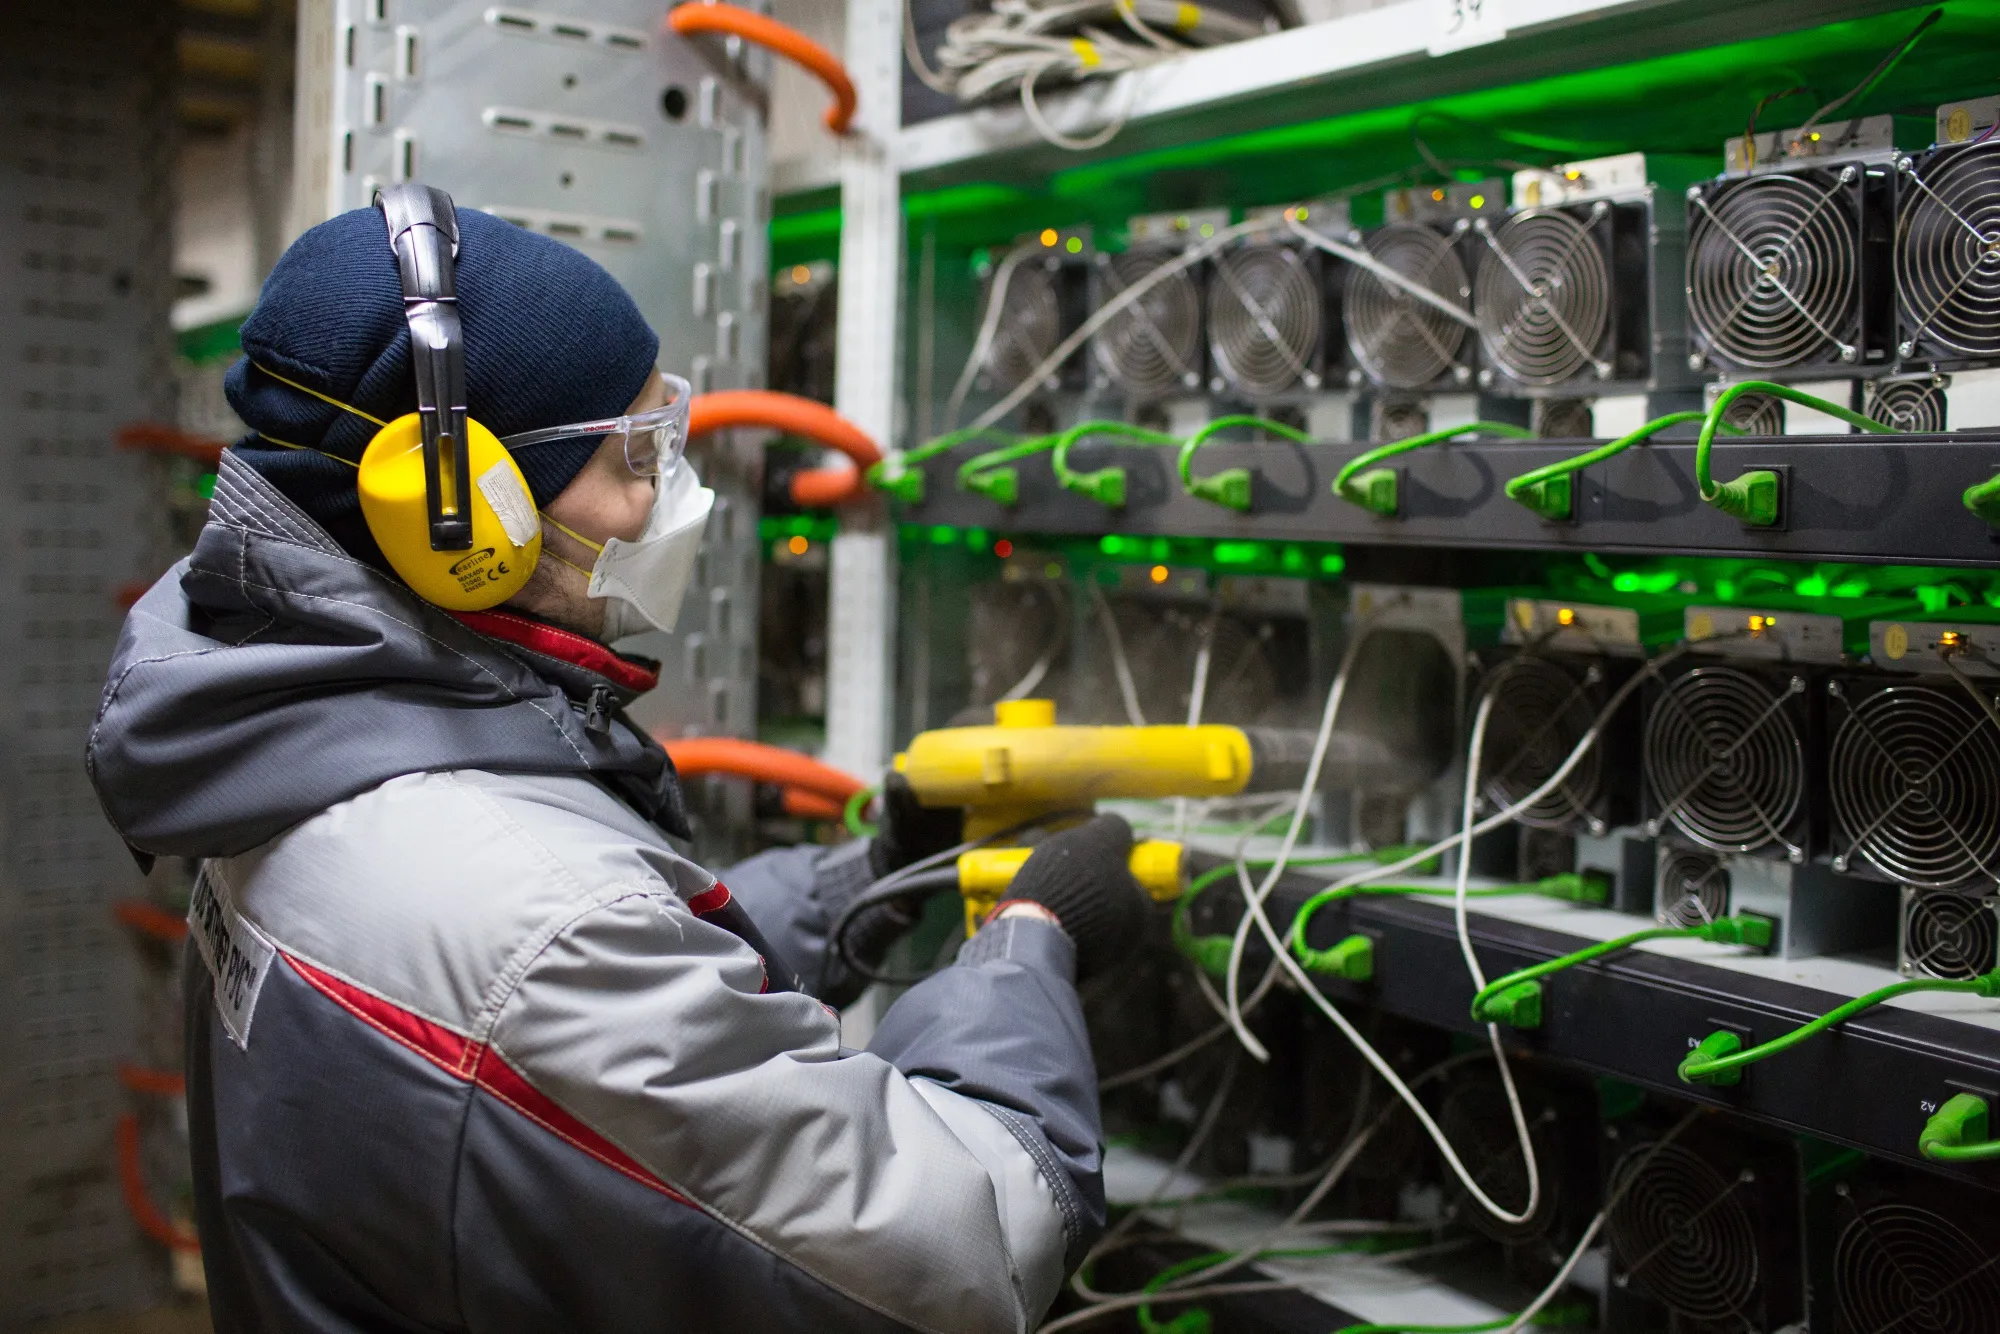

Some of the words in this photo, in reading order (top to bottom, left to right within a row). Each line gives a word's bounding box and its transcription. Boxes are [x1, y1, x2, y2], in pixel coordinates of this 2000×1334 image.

[457, 553, 490, 573] earline
[457, 567, 485, 583] MAX400
[1920, 1100, 1936, 1113] A2
